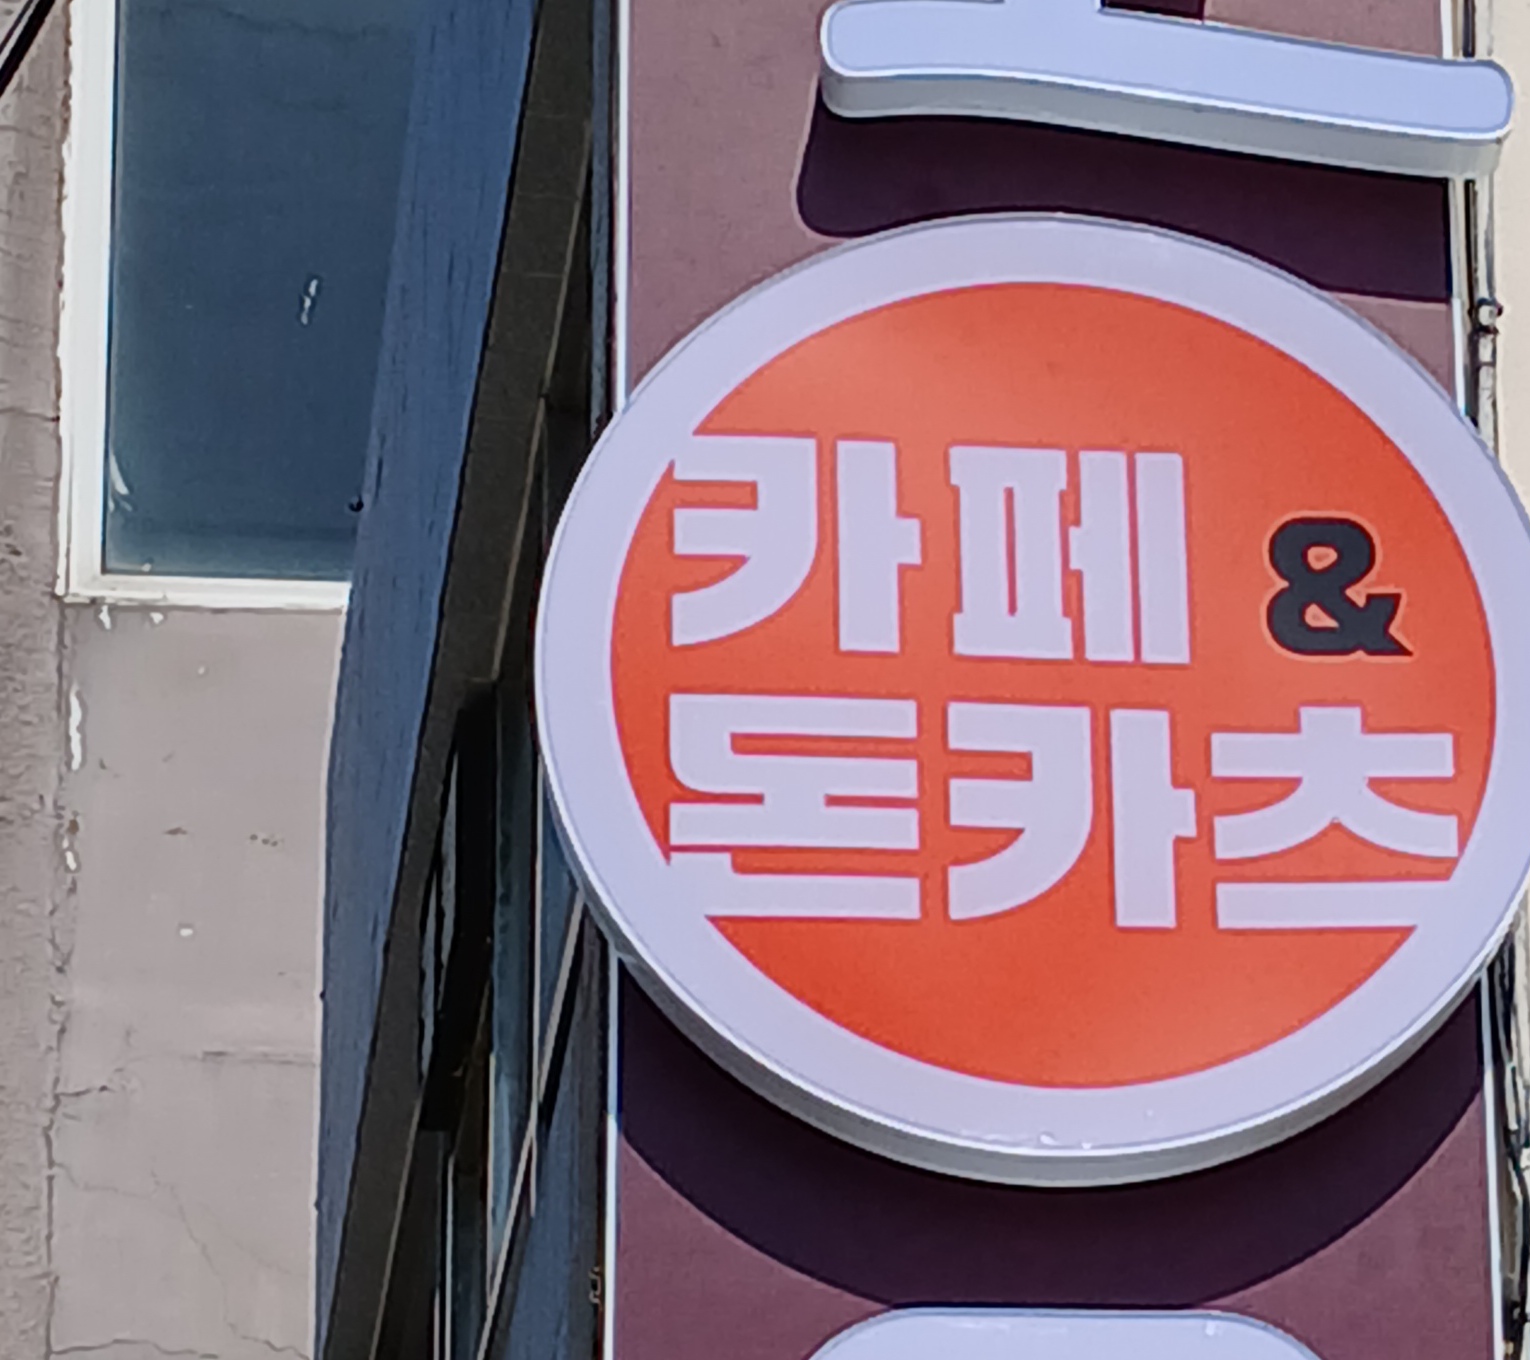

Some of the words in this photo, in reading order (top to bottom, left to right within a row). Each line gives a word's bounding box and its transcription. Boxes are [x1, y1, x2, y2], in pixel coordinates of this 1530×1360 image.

[671, 435, 1192, 665] 카페
[1266, 516, 1413, 657] &
[668, 693, 1459, 929] 돈카츠
